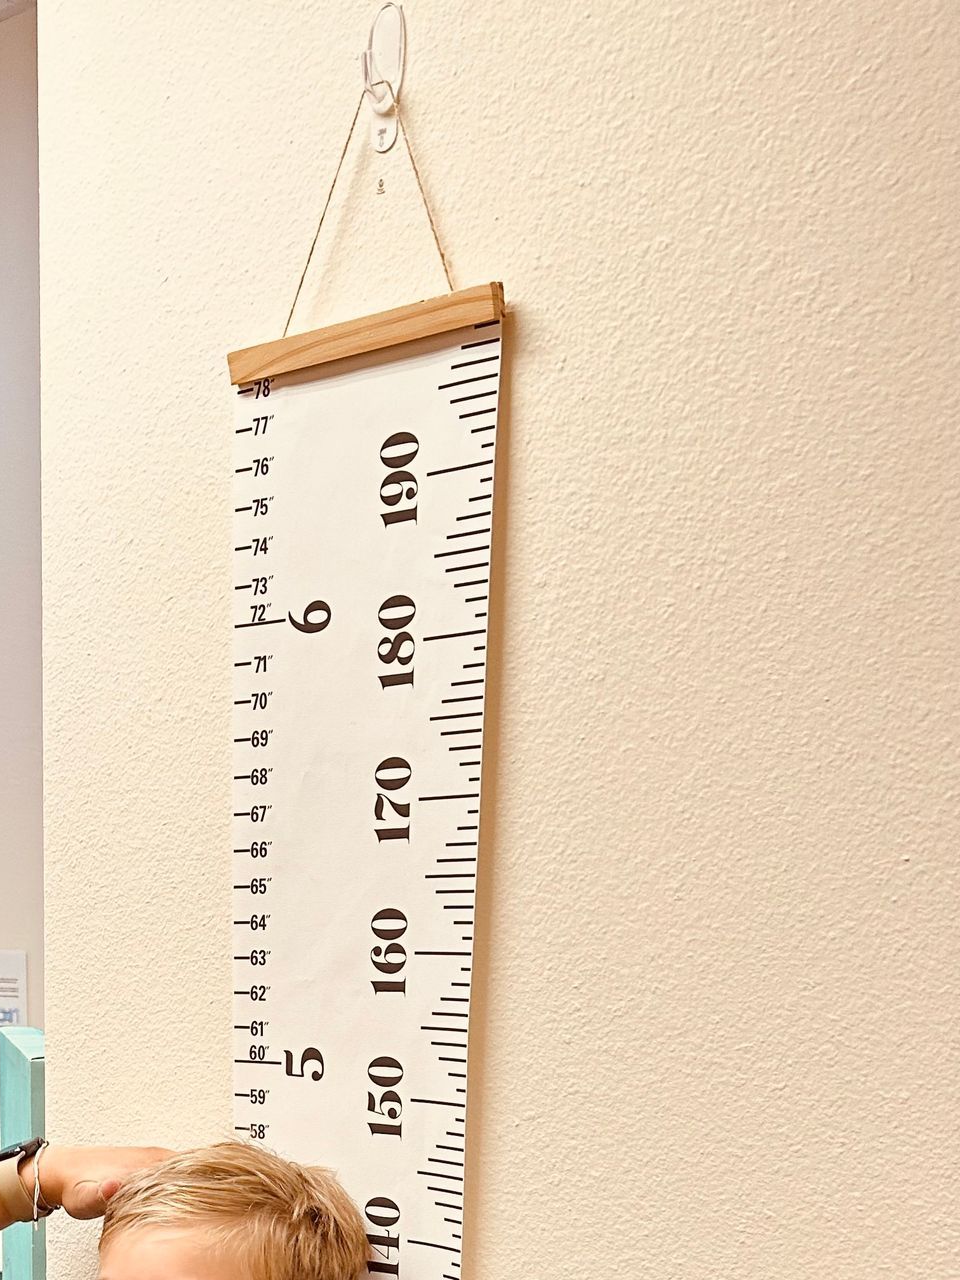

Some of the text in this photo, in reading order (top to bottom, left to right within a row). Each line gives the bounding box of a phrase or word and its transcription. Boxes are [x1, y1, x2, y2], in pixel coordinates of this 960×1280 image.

[380, 431, 419, 528] 190
[288, 599, 332, 634] 6
[378, 594, 416, 691] 180
[374, 757, 412, 844] 170
[370, 908, 408, 998] 160
[283, 1047, 324, 1081] 5
[367, 1056, 403, 1139] 150
[365, 1196, 400, 1280] 140
